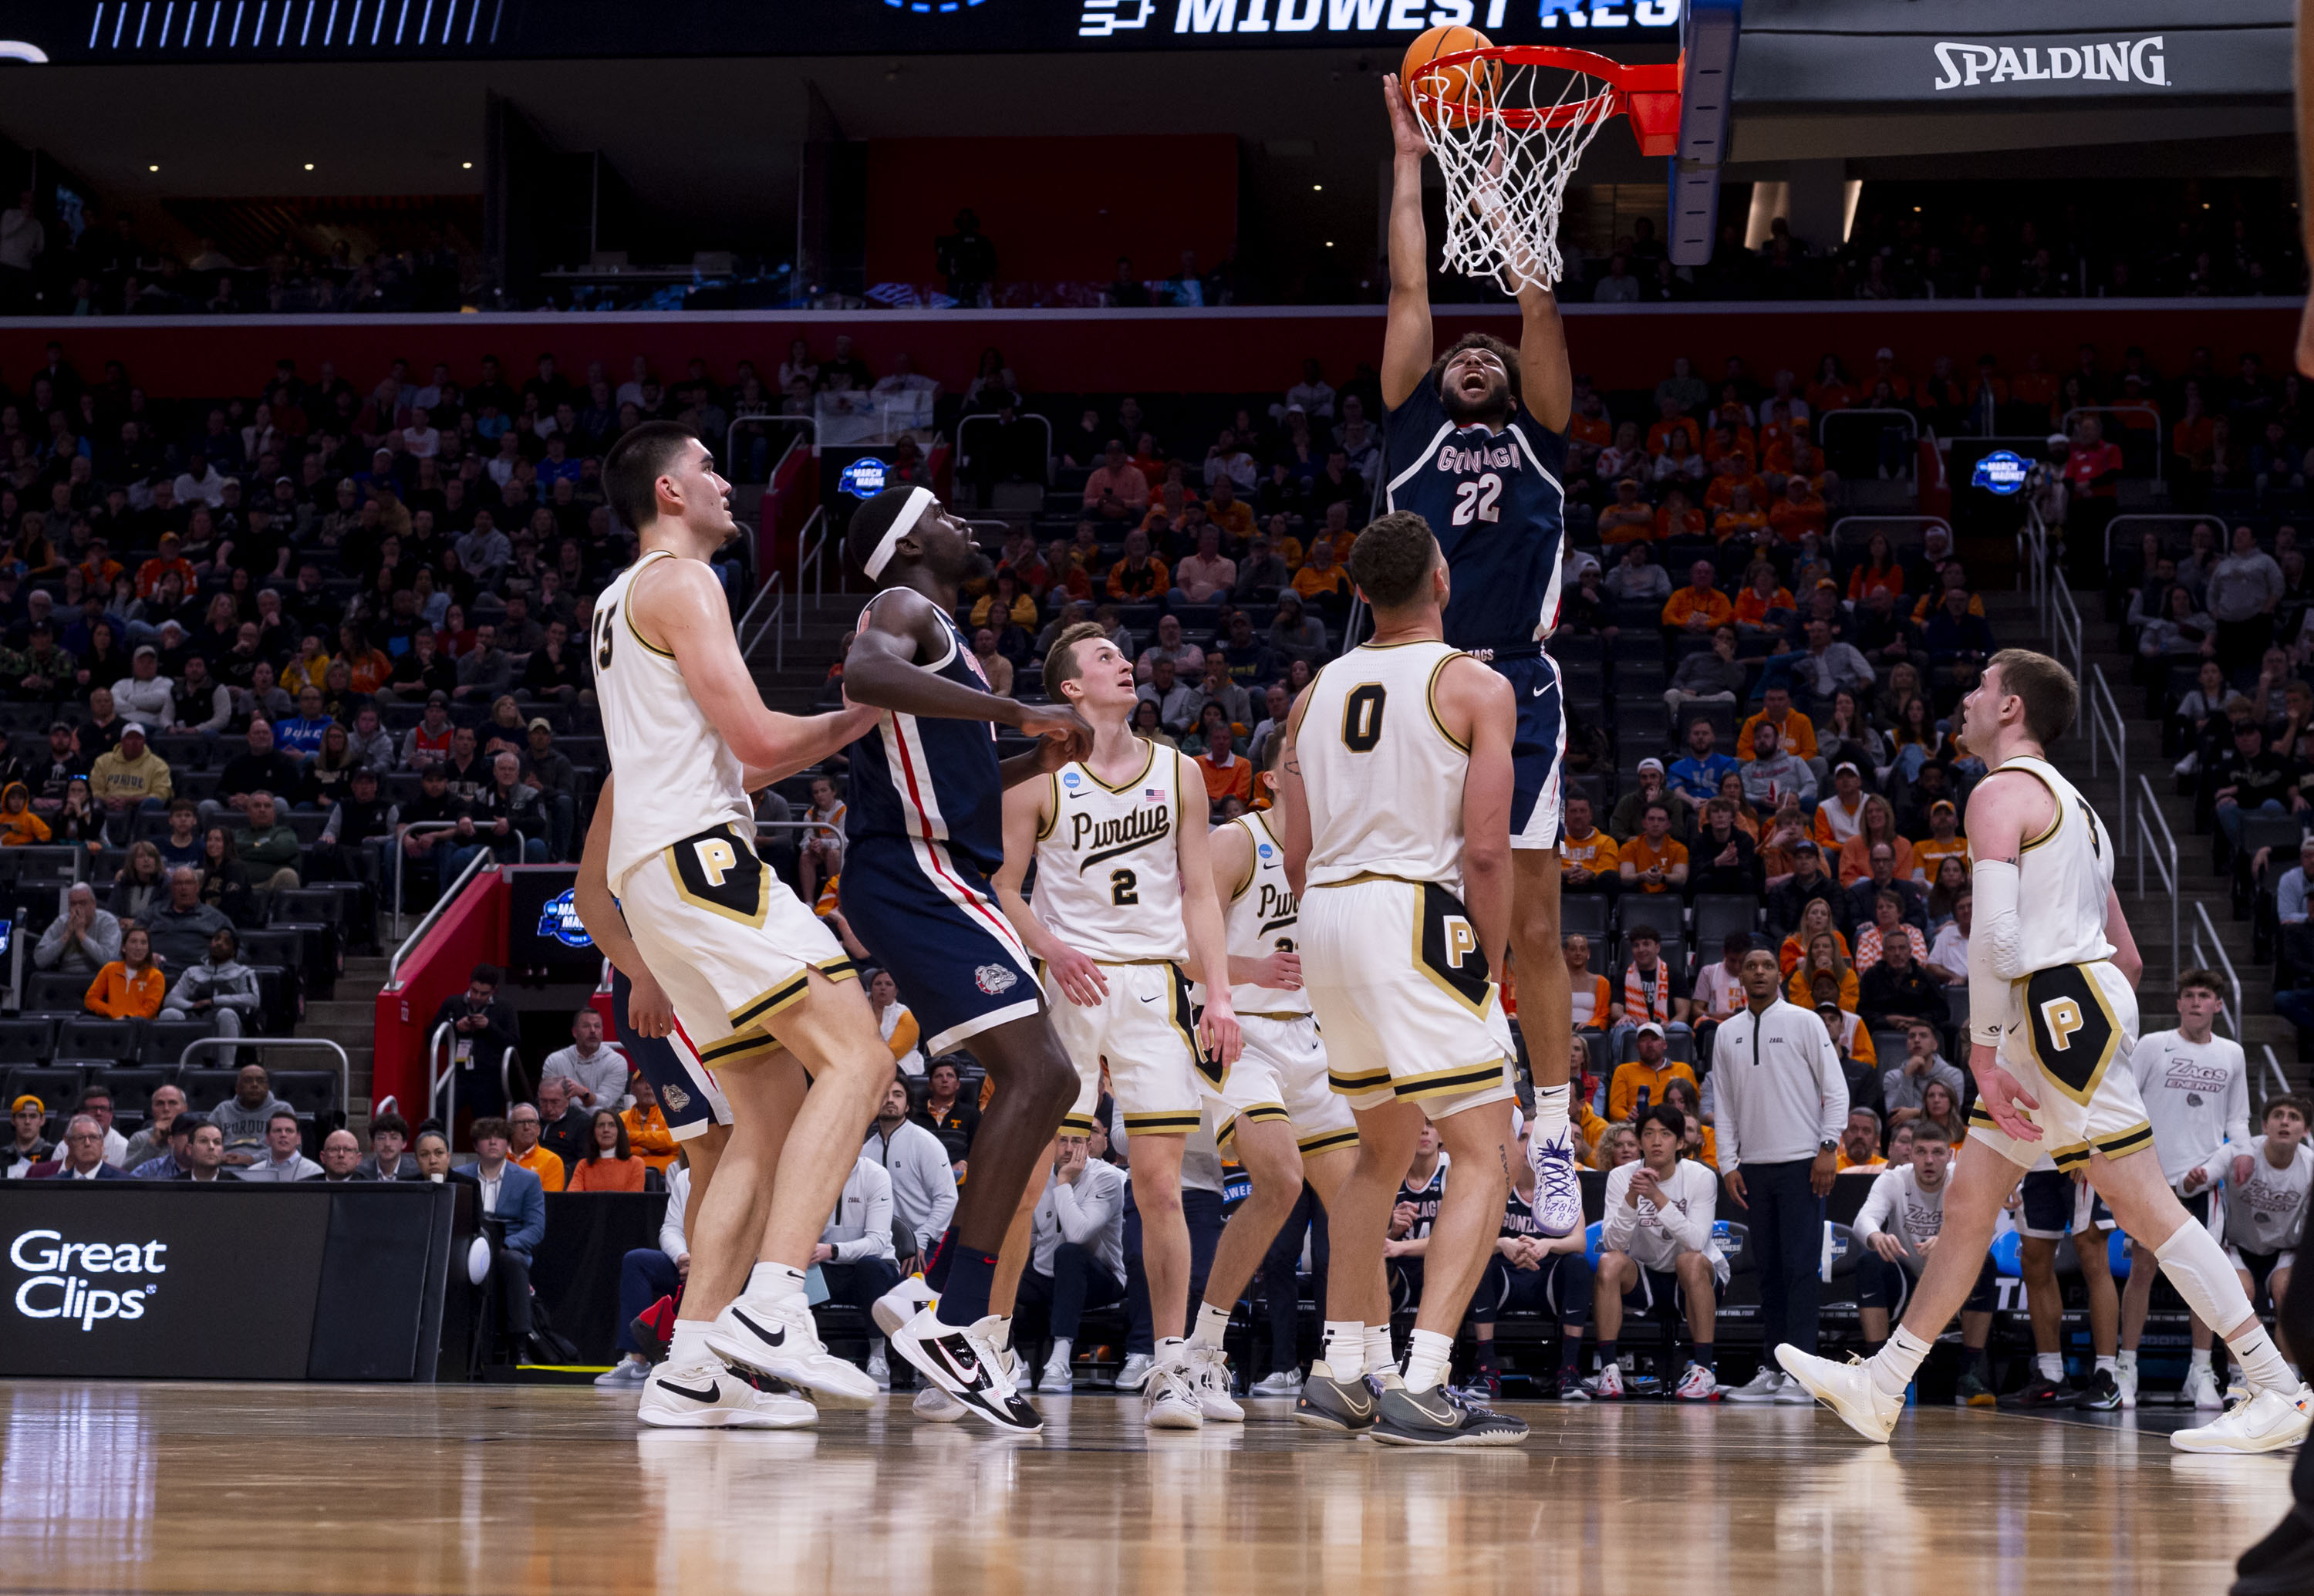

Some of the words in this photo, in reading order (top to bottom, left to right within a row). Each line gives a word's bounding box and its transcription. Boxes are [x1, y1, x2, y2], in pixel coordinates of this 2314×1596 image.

[1173, 0, 1509, 34] MIDWEST
[1934, 35, 2166, 90] SPALDING
[1452, 472, 1503, 525] 22
[592, 597, 619, 677] 15
[1341, 682, 1387, 753] 0
[1068, 803, 1171, 852] Purdue
[693, 837, 737, 888] P
[1109, 868, 1139, 907] 2
[1443, 915, 1476, 969] P
[2040, 996, 2084, 1051] P
[2164, 1078, 2226, 1093] ENERGY
[2166, 1058, 2228, 1081] ZAGS
[10, 1230, 167, 1273] Great
[15, 1276, 146, 1331] Clips
